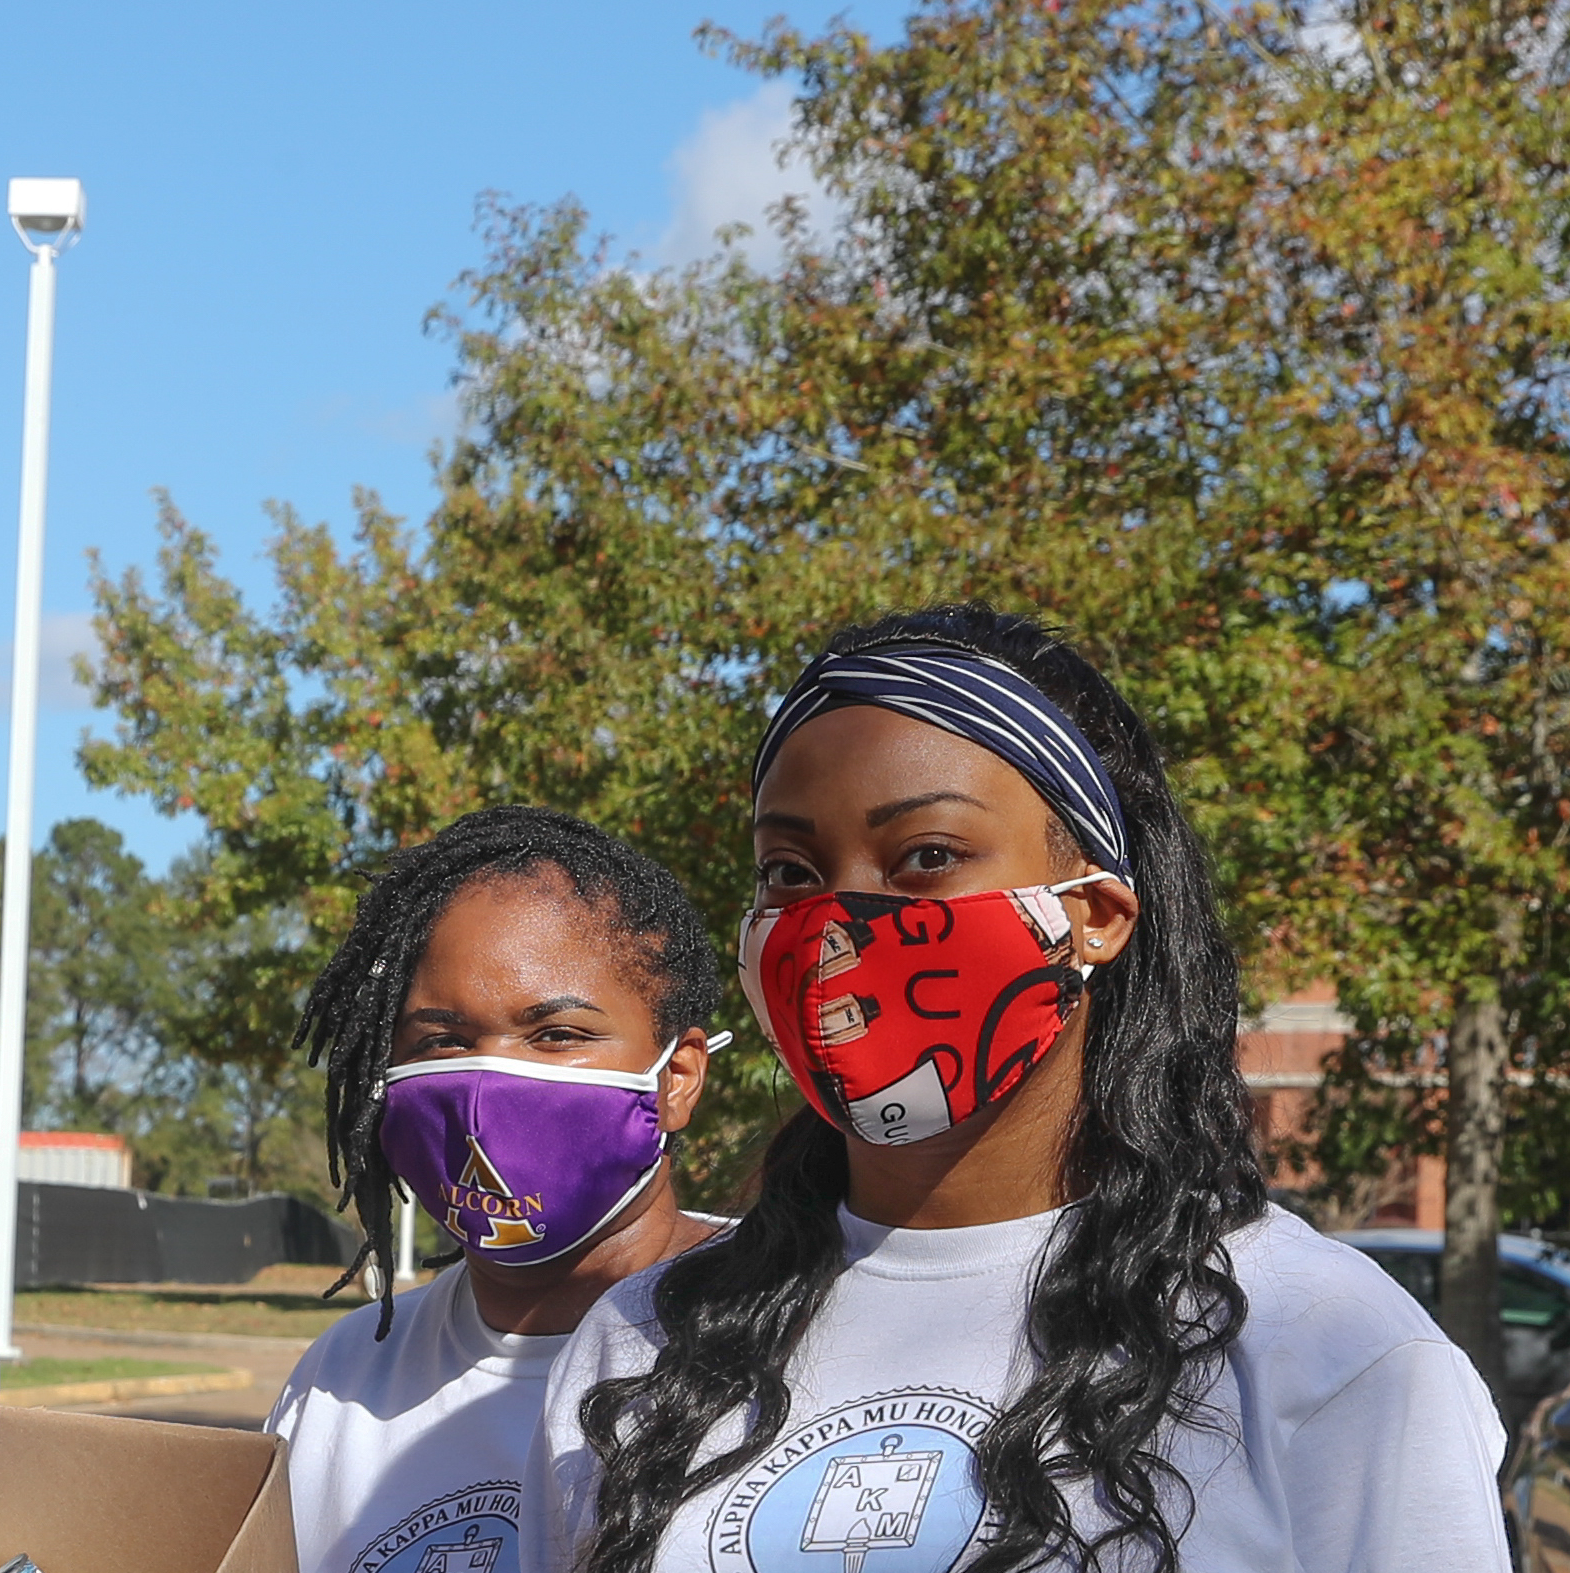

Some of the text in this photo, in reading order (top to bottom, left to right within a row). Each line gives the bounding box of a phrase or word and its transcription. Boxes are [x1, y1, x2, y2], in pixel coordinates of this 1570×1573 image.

[719, 1401, 989, 1556] ALPHA KAPPA MU HONO
[833, 1465, 861, 1489] A
[856, 1487, 888, 1512] K
[376, 1508, 449, 1559] KAPPA
[454, 1494, 488, 1518] MU
[874, 1512, 909, 1538] M
